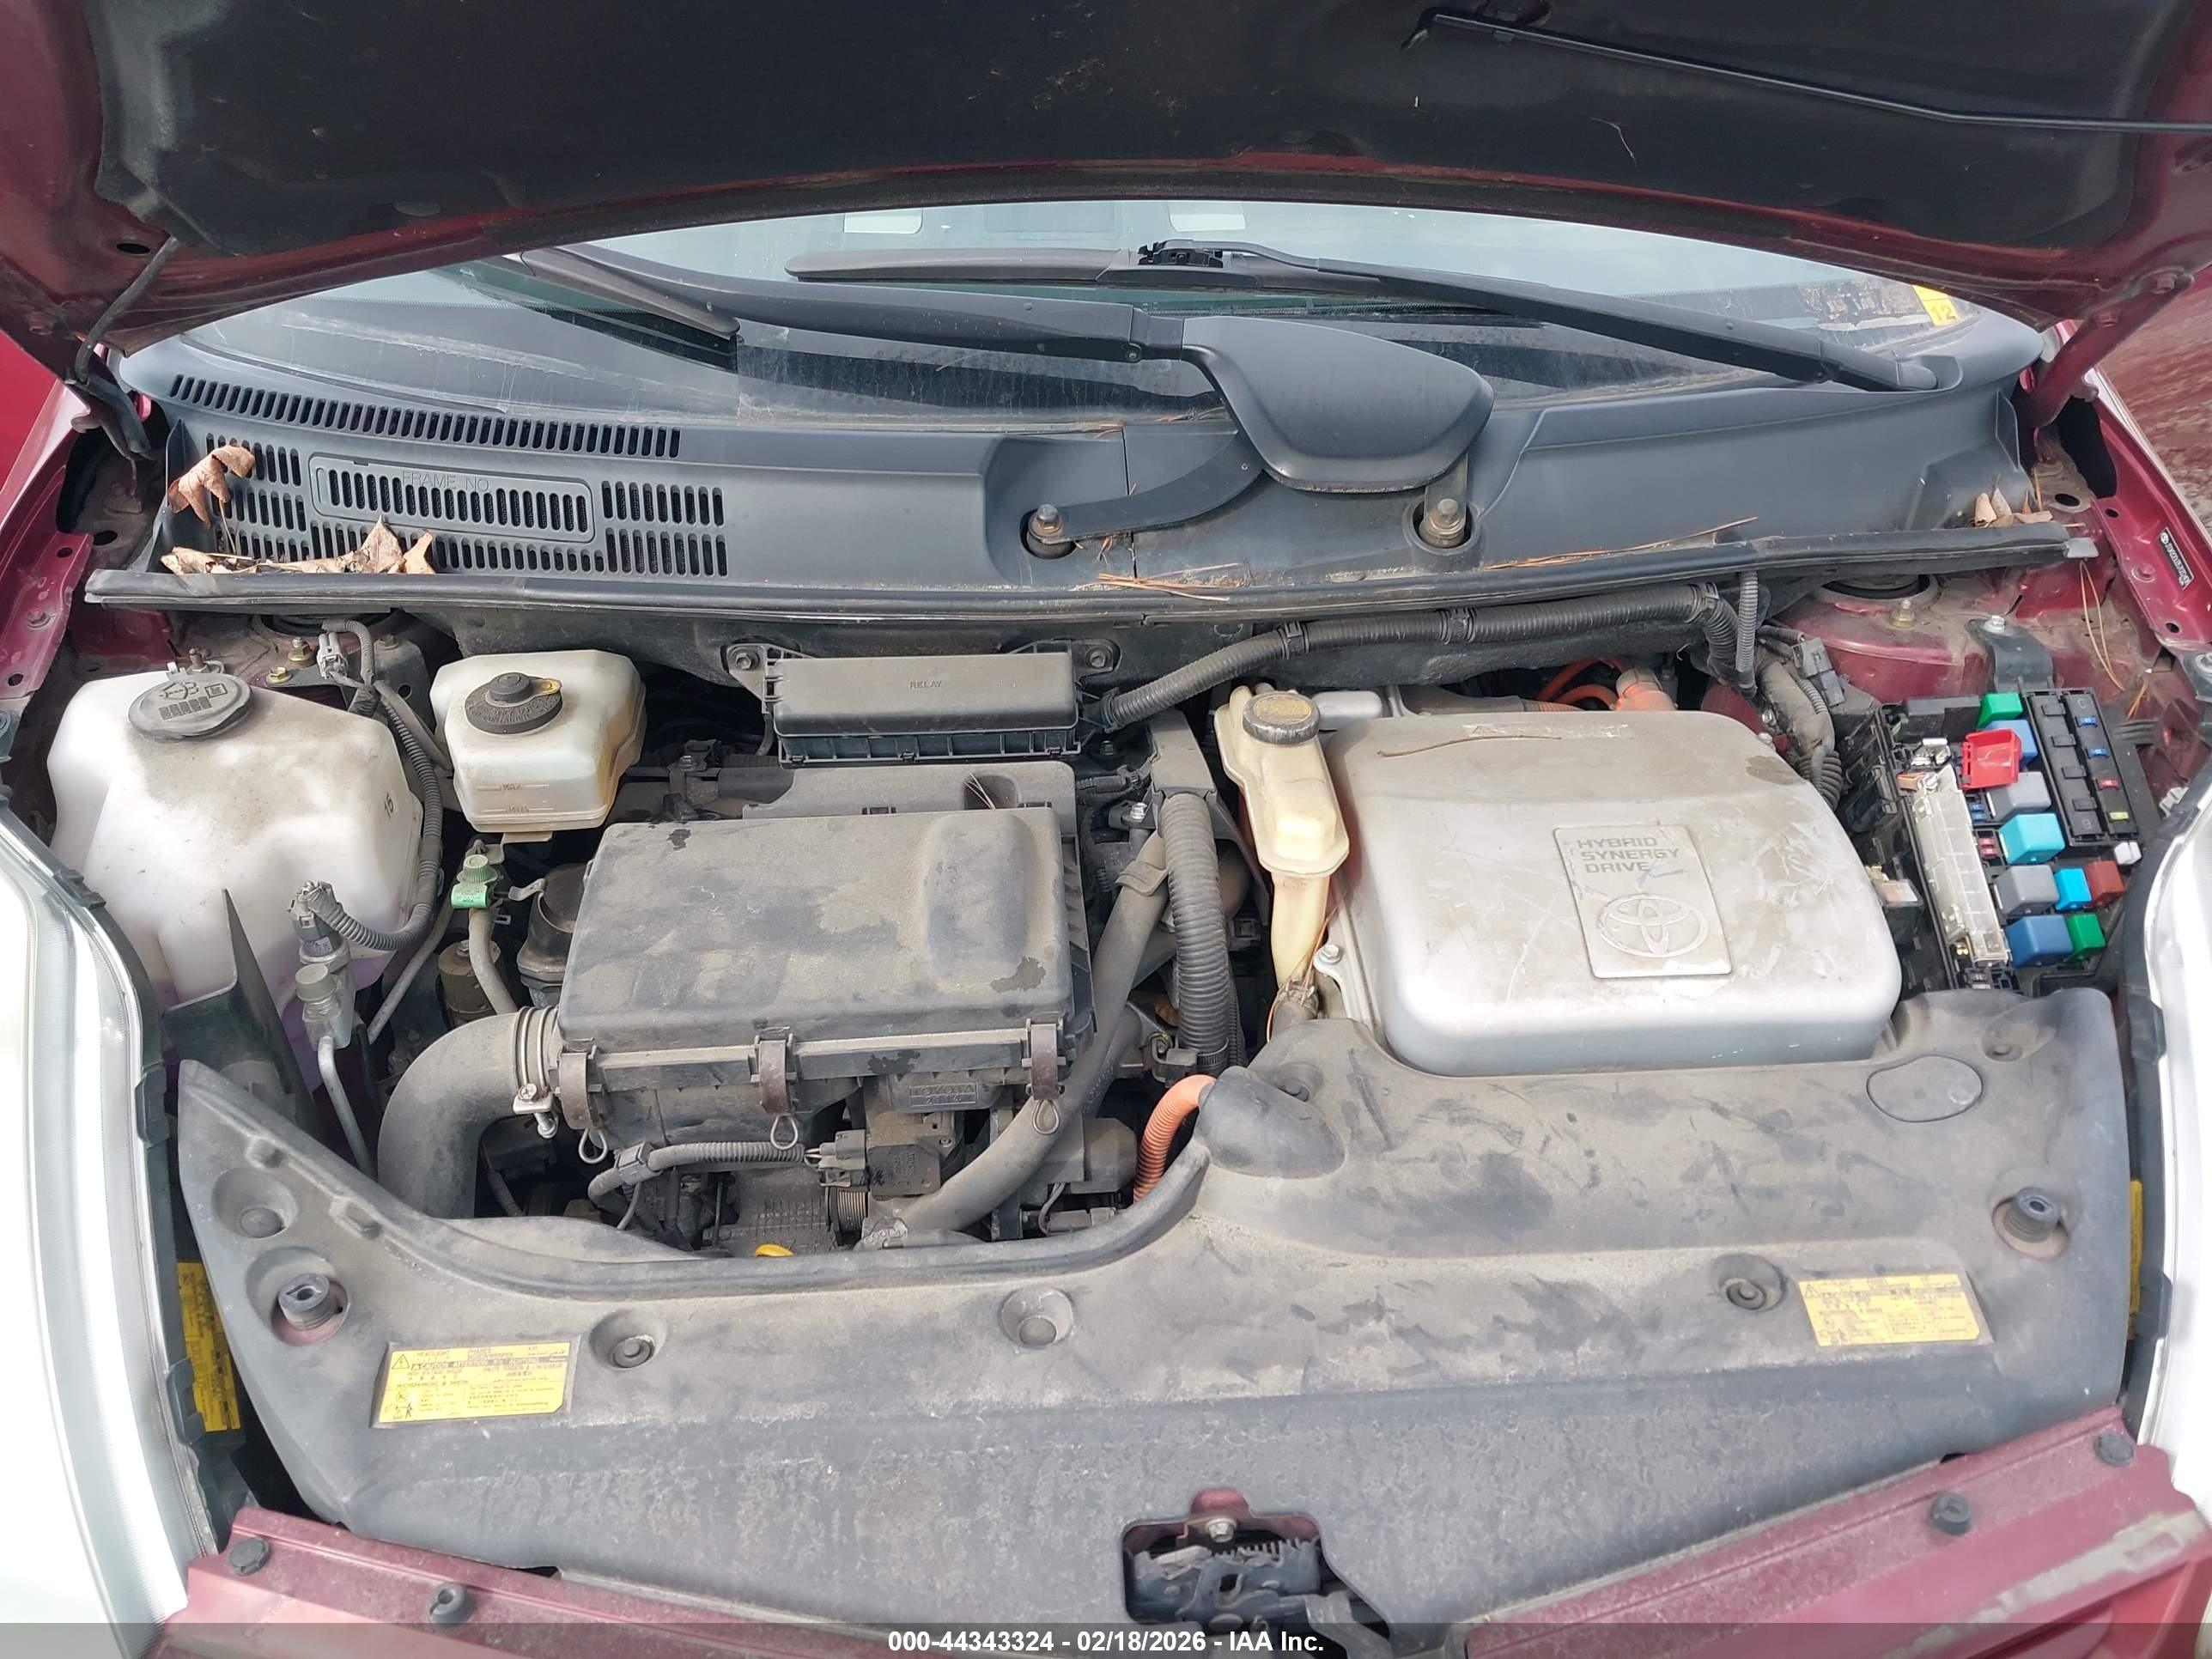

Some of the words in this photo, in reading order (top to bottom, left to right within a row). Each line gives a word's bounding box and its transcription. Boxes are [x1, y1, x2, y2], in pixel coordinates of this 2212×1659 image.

[1930, 305, 1956, 321] 12
[402, 471, 457, 489] FRAME
[909, 680, 942, 689] RELAY
[1577, 837, 1658, 849] HYBRID
[1580, 848, 1680, 861] SYNERGY
[1584, 861, 1650, 873] DRIVE
[910, 1085, 975, 1096] TOYOTA
